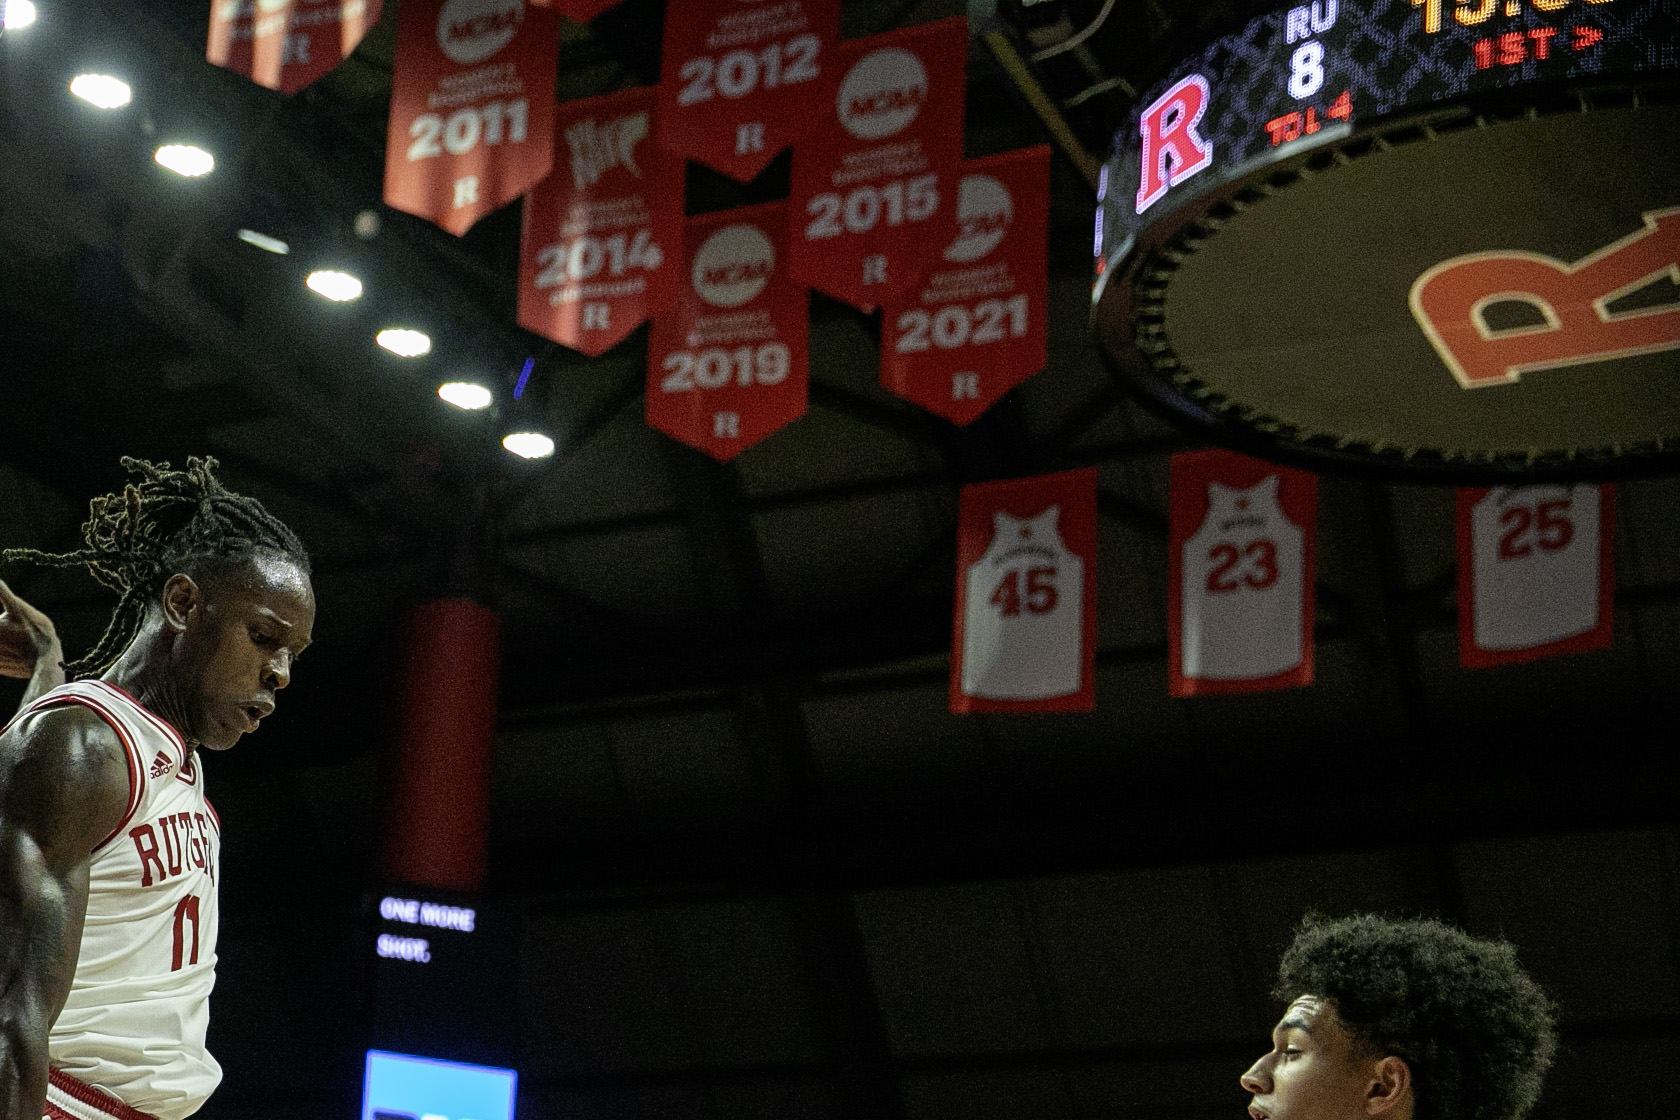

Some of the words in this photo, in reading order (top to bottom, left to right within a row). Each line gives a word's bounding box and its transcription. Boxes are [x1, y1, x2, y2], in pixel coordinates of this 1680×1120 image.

[1286, 0, 1340, 44] RU
[1474, 27, 1559, 69] 1ST
[678, 34, 820, 106] 2012
[1287, 40, 1325, 100] 8
[408, 98, 529, 162] 2011
[1135, 73, 1213, 215] R
[805, 174, 941, 241] 2015
[534, 228, 664, 290] 2014
[895, 294, 1029, 354] 2021
[660, 341, 791, 393] 2019
[1499, 499, 1574, 561] 25
[989, 566, 1060, 618] 45
[1204, 539, 1279, 595] 23
[380, 896, 420, 925] ONE
[420, 902, 476, 932] MORE
